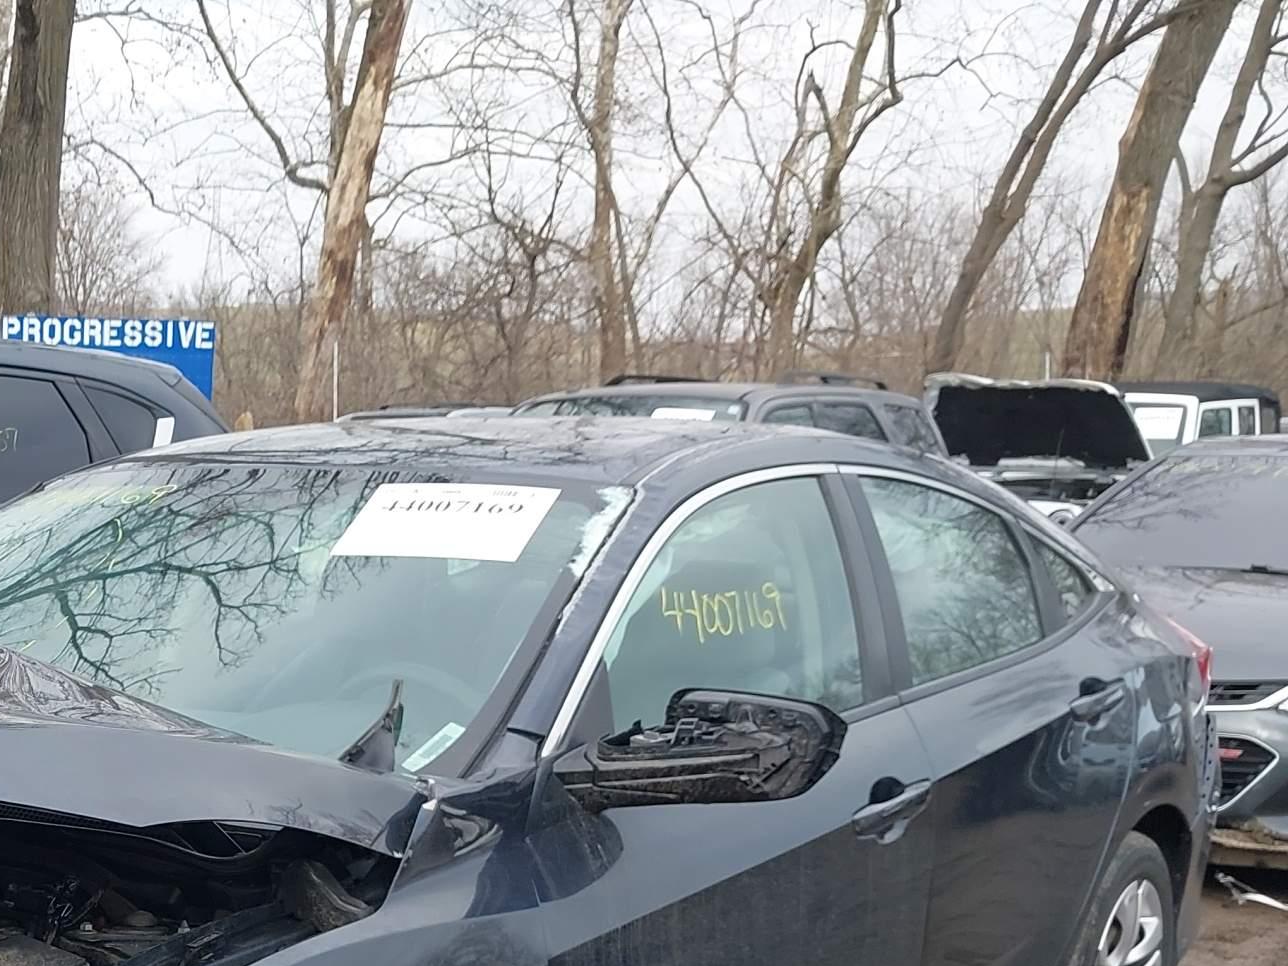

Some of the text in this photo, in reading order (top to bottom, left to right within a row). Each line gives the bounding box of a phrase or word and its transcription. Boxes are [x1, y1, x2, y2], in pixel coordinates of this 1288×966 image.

[2, 315, 215, 349] PROGRESSIVE
[381, 499, 524, 514] 44007169
[662, 582, 787, 643] 44007169
